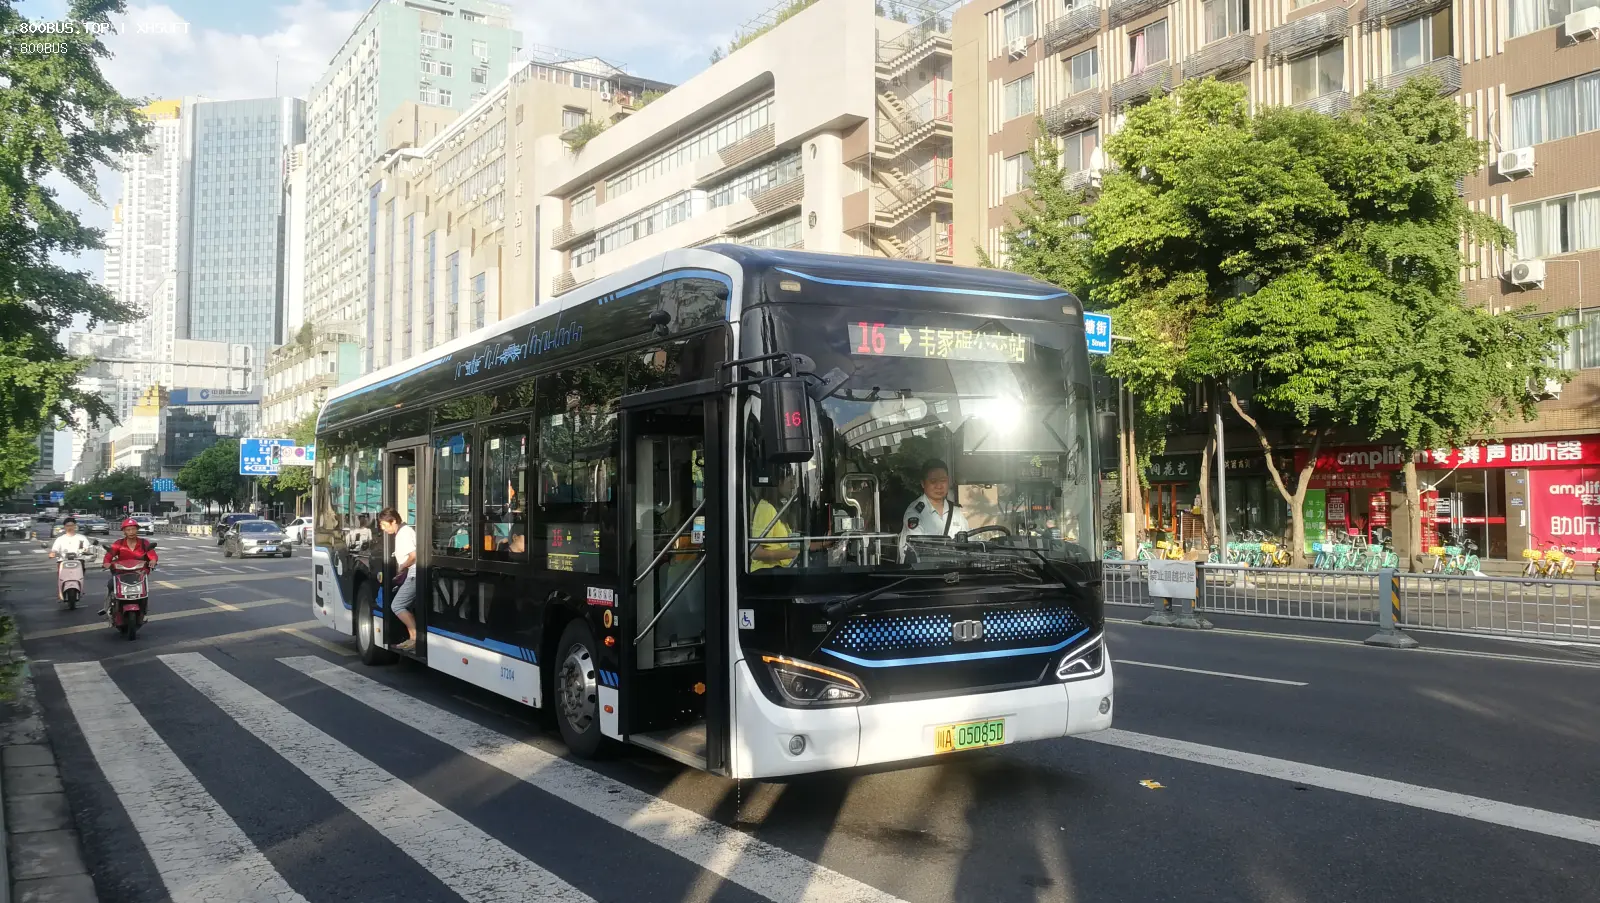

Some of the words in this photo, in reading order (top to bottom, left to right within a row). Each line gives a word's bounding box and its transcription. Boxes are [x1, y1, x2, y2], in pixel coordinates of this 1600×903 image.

[857, 321, 887, 355] 16
[784, 411, 802, 428] 16
[1337, 445, 1429, 470] amplifn
[1550, 515, 1600, 536] 助听
[1149, 569, 1195, 583] 禁止翻越护栏
[958, 722, 1004, 746] 05085D
